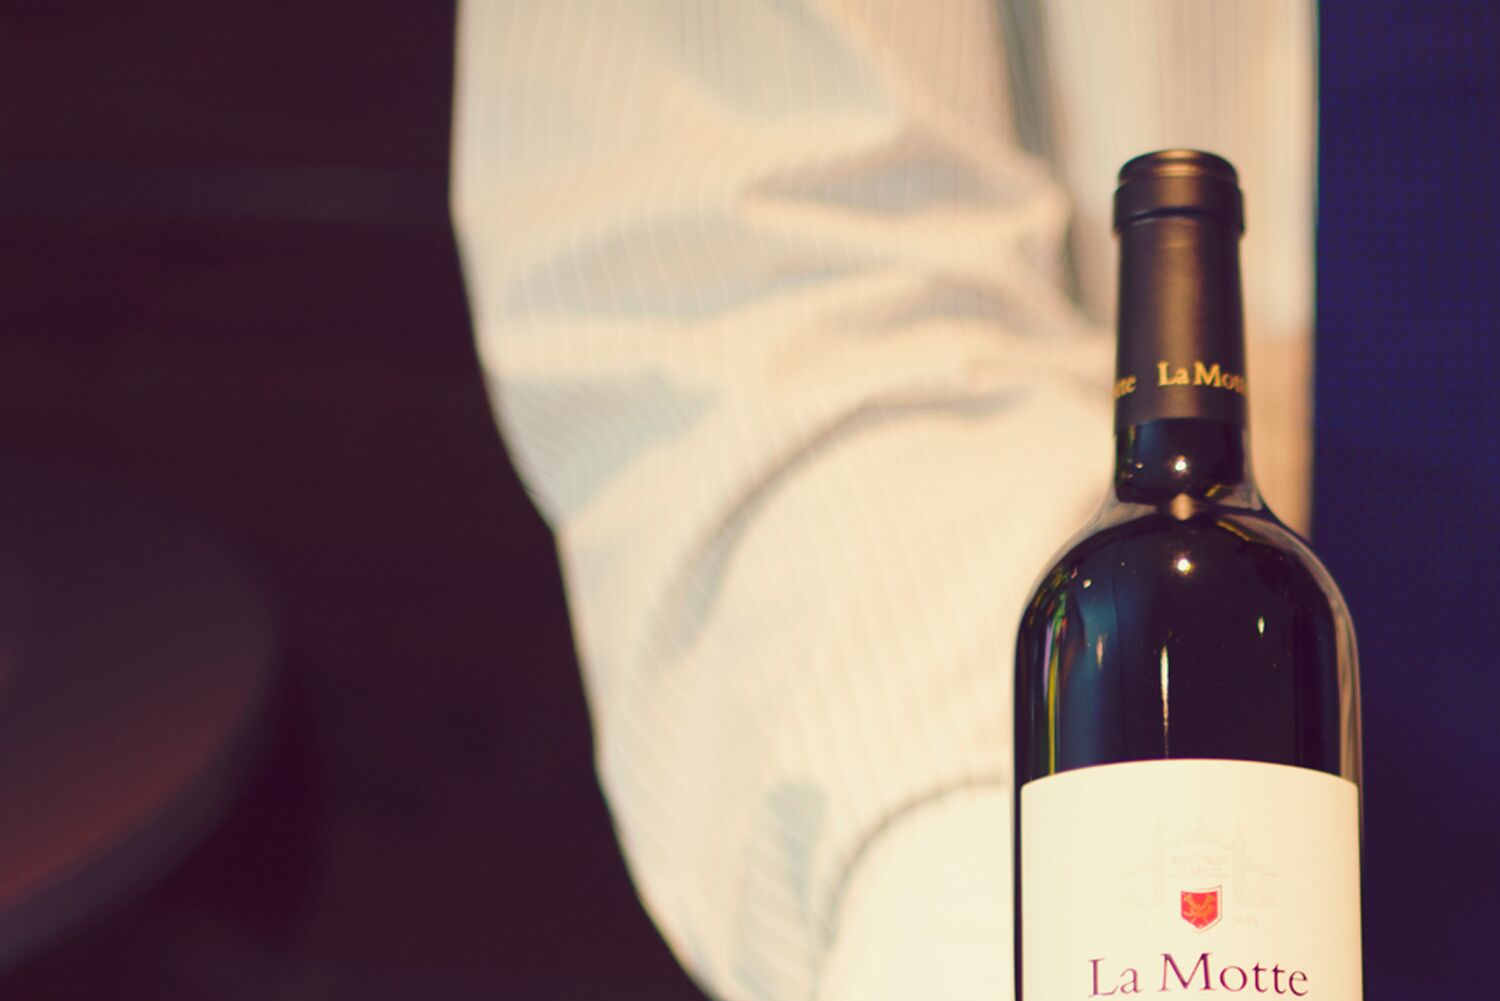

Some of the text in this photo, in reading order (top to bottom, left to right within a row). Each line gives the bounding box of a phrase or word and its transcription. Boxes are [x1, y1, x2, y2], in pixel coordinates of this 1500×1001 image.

[1157, 361, 1189, 386] La
[1088, 951, 1309, 998] La Motte
